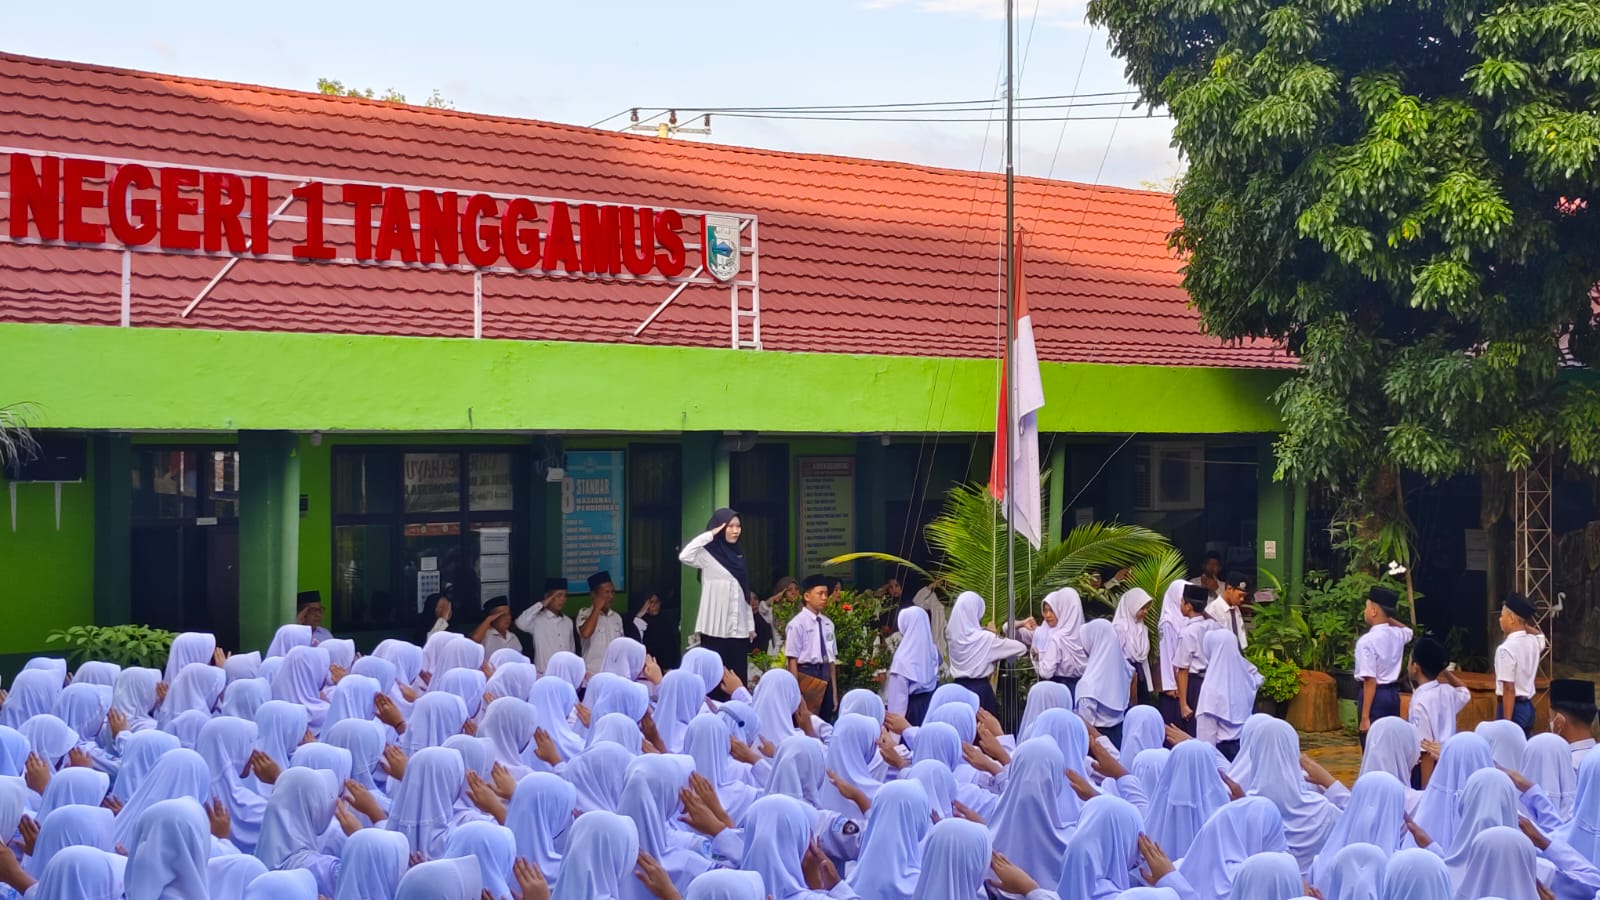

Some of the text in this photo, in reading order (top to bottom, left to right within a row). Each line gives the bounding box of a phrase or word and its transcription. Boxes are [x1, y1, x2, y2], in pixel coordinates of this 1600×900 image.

[9, 152, 686, 277] NEGERI 1 TANGGAMUS
[562, 477, 609, 513] 8 STANDAR
